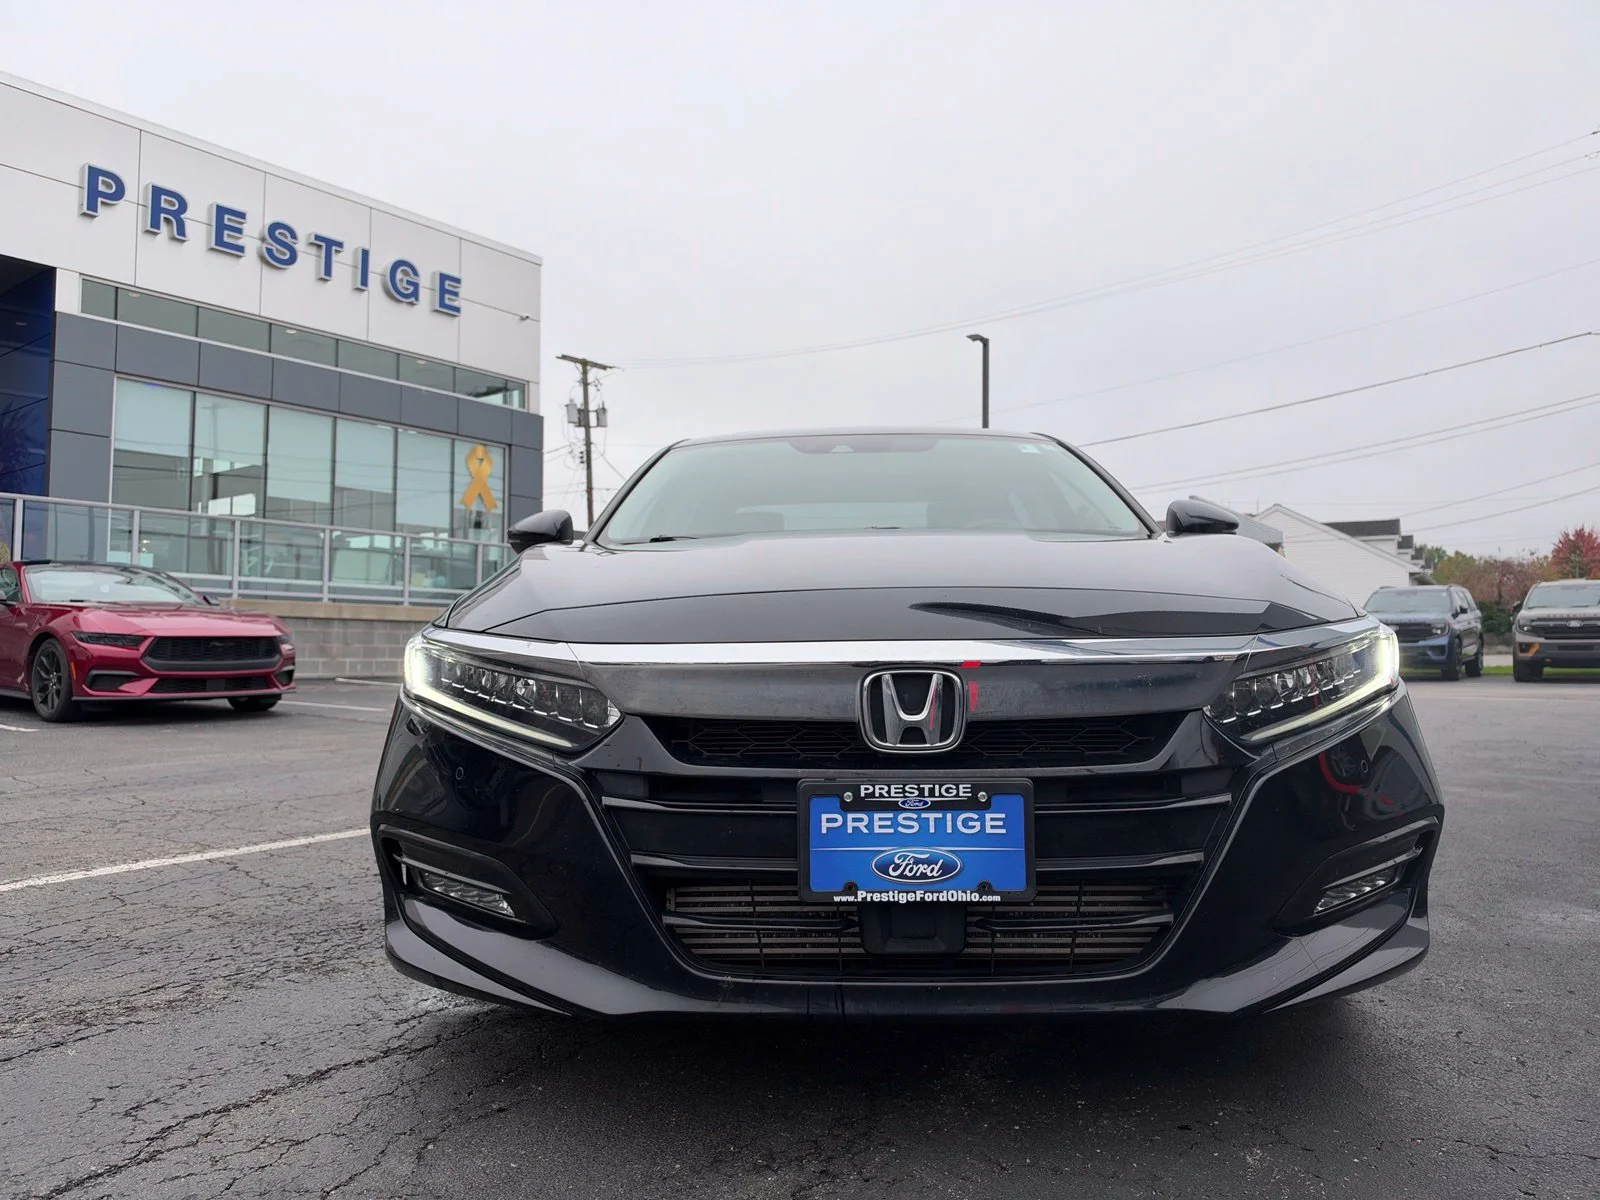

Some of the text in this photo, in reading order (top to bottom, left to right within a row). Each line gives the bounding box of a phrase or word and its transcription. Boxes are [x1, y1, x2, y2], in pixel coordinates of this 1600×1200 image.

[80, 162, 463, 317] PRESTIGE
[860, 784, 972, 797] PRESTIGE
[821, 813, 1007, 834] PRESTIGE
[888, 852, 944, 878] Ford
[833, 890, 1001, 904] www.PrestigeFordOhio.com
